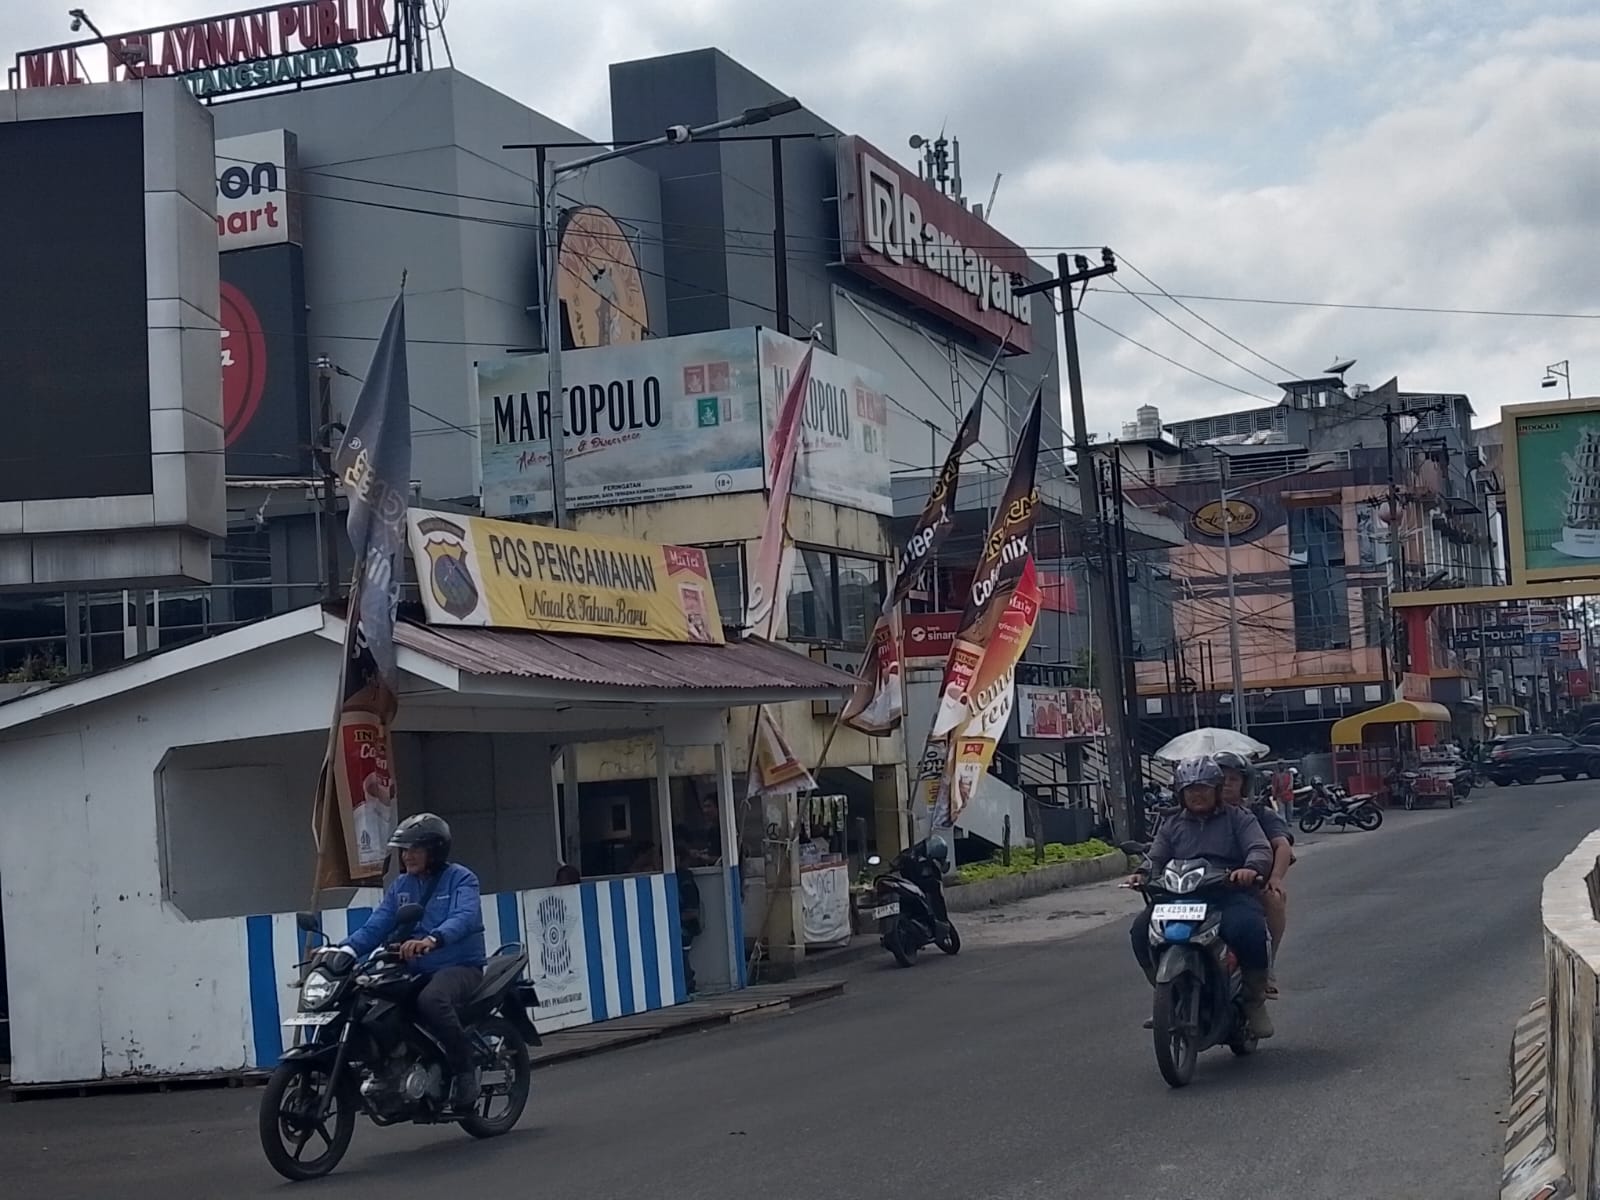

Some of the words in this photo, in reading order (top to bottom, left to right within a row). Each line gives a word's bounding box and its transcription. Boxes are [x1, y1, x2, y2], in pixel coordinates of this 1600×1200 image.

[25, 47, 84, 88] MAL
[277, 0, 390, 53] PUBLIK
[214, 161, 278, 200] on
[489, 534, 532, 578] POS
[532, 540, 657, 593] PENGAMANAN
[529, 590, 565, 620] Natal
[566, 595, 578, 621] &
[577, 594, 614, 623] Tahun
[614, 597, 648, 627] Baru
